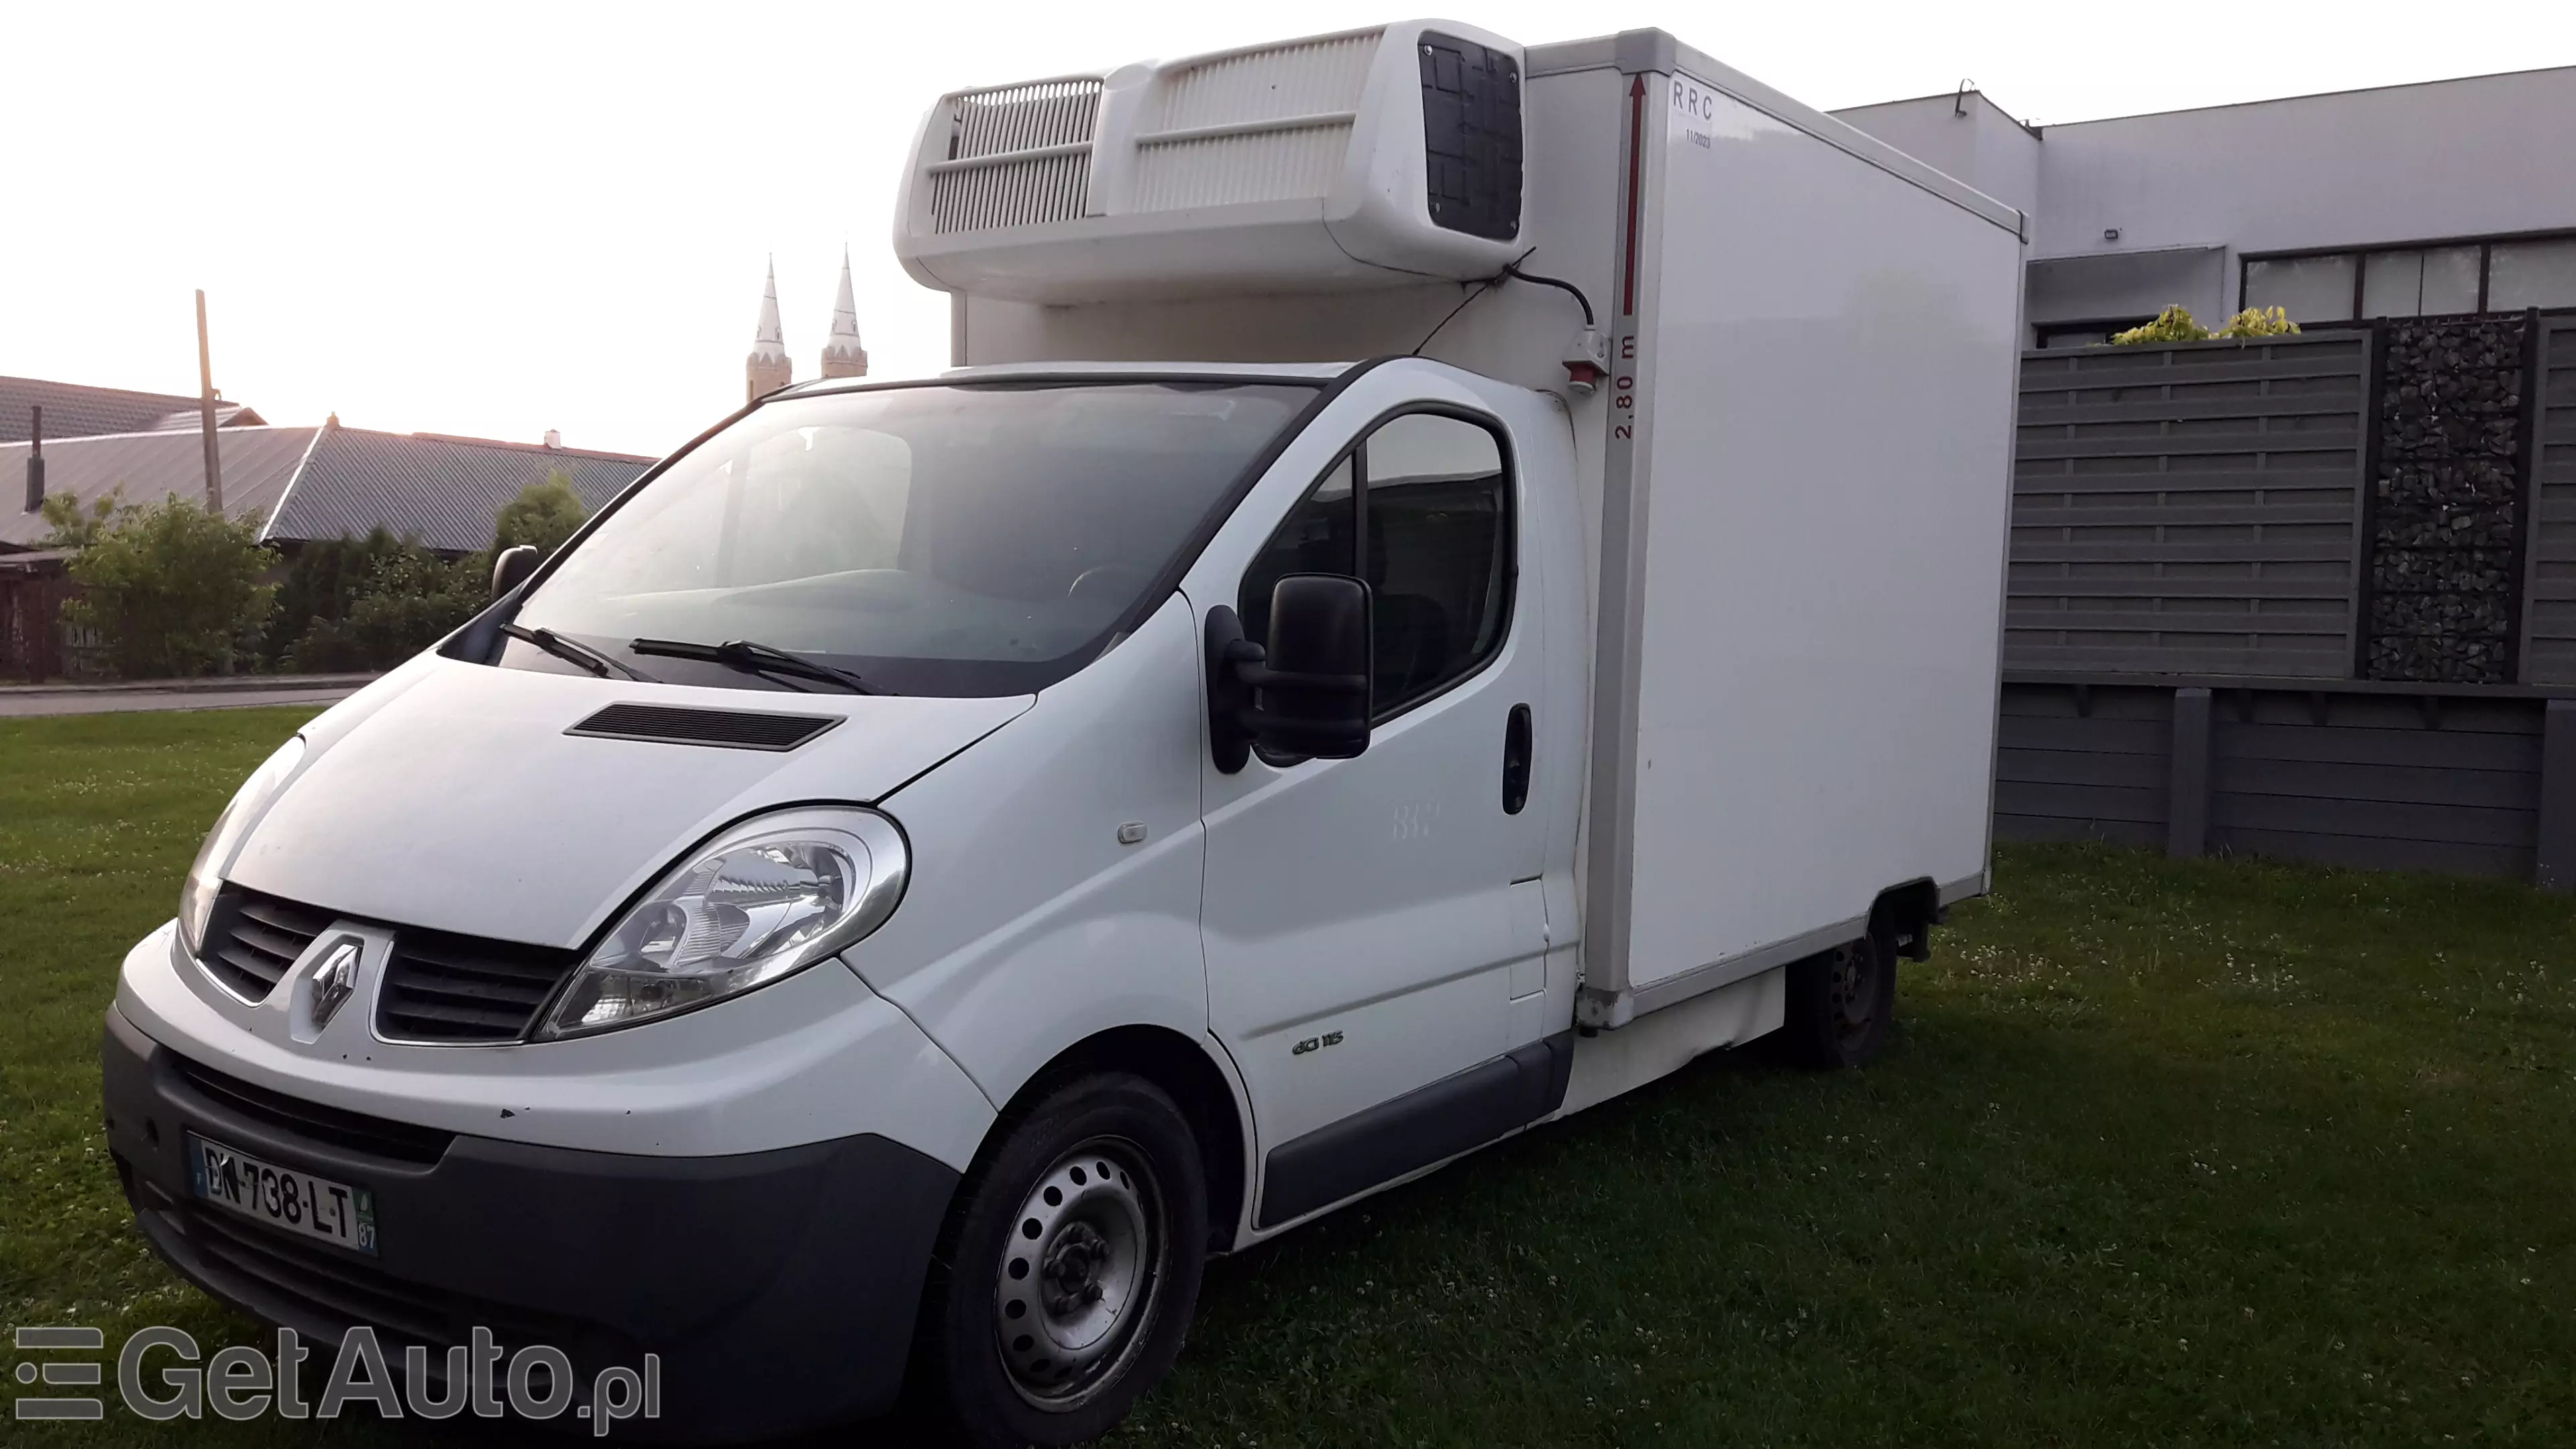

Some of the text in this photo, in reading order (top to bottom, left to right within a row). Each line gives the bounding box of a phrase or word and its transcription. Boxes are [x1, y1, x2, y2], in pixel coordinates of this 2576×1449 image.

[1686, 129, 1711, 149] 11/2023
[1615, 335, 1635, 439] 2,80 m
[358, 1224, 375, 1249] 87
